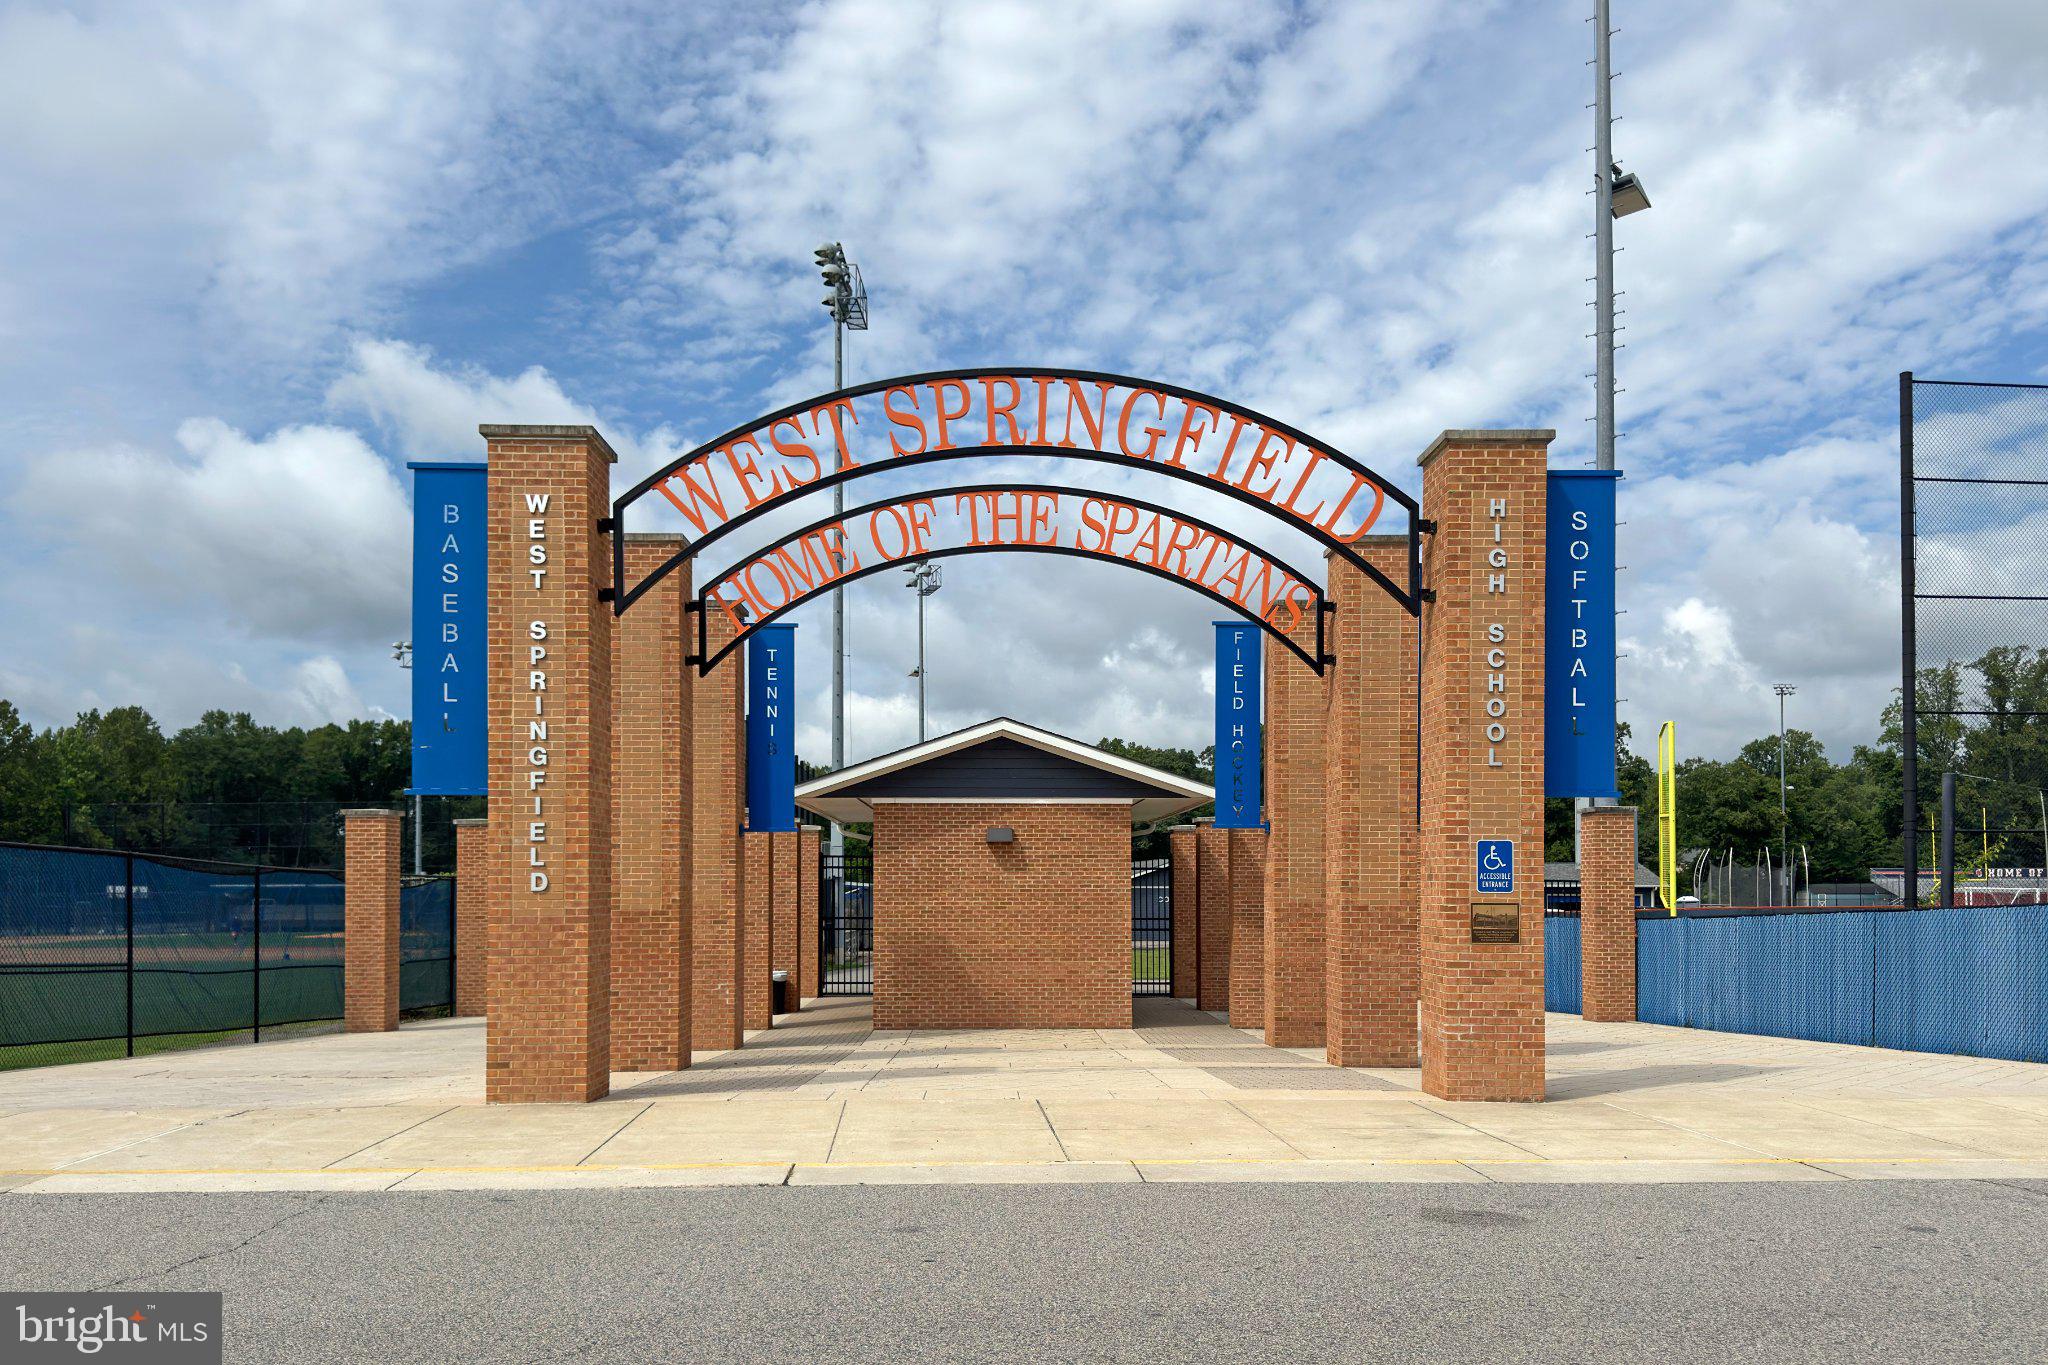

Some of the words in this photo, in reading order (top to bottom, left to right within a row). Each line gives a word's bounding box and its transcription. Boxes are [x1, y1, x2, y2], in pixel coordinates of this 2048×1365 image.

[652, 397, 861, 535] WEST
[883, 376, 1385, 544] SPRINGFIELD
[525, 494, 549, 589] WEST
[706, 521, 862, 637] HOME
[869, 498, 937, 561] OF
[955, 491, 1059, 546] THE
[1075, 497, 1318, 635] SPARTANS
[1488, 498, 1506, 593] HIGH
[441, 504, 460, 732] BASEBALL
[1233, 631, 1244, 710] FIELD
[1570, 511, 1589, 736] SOFTBALL
[1486, 623, 1506, 767] SCHOOL
[528, 620, 549, 892] SPRINGFIELD
[1232, 725, 1244, 817] HOCKEY
[1480, 872, 1511, 880] ACCESSIBLE
[1988, 868, 2022, 877] HOME
[2028, 868, 2044, 877] OF
